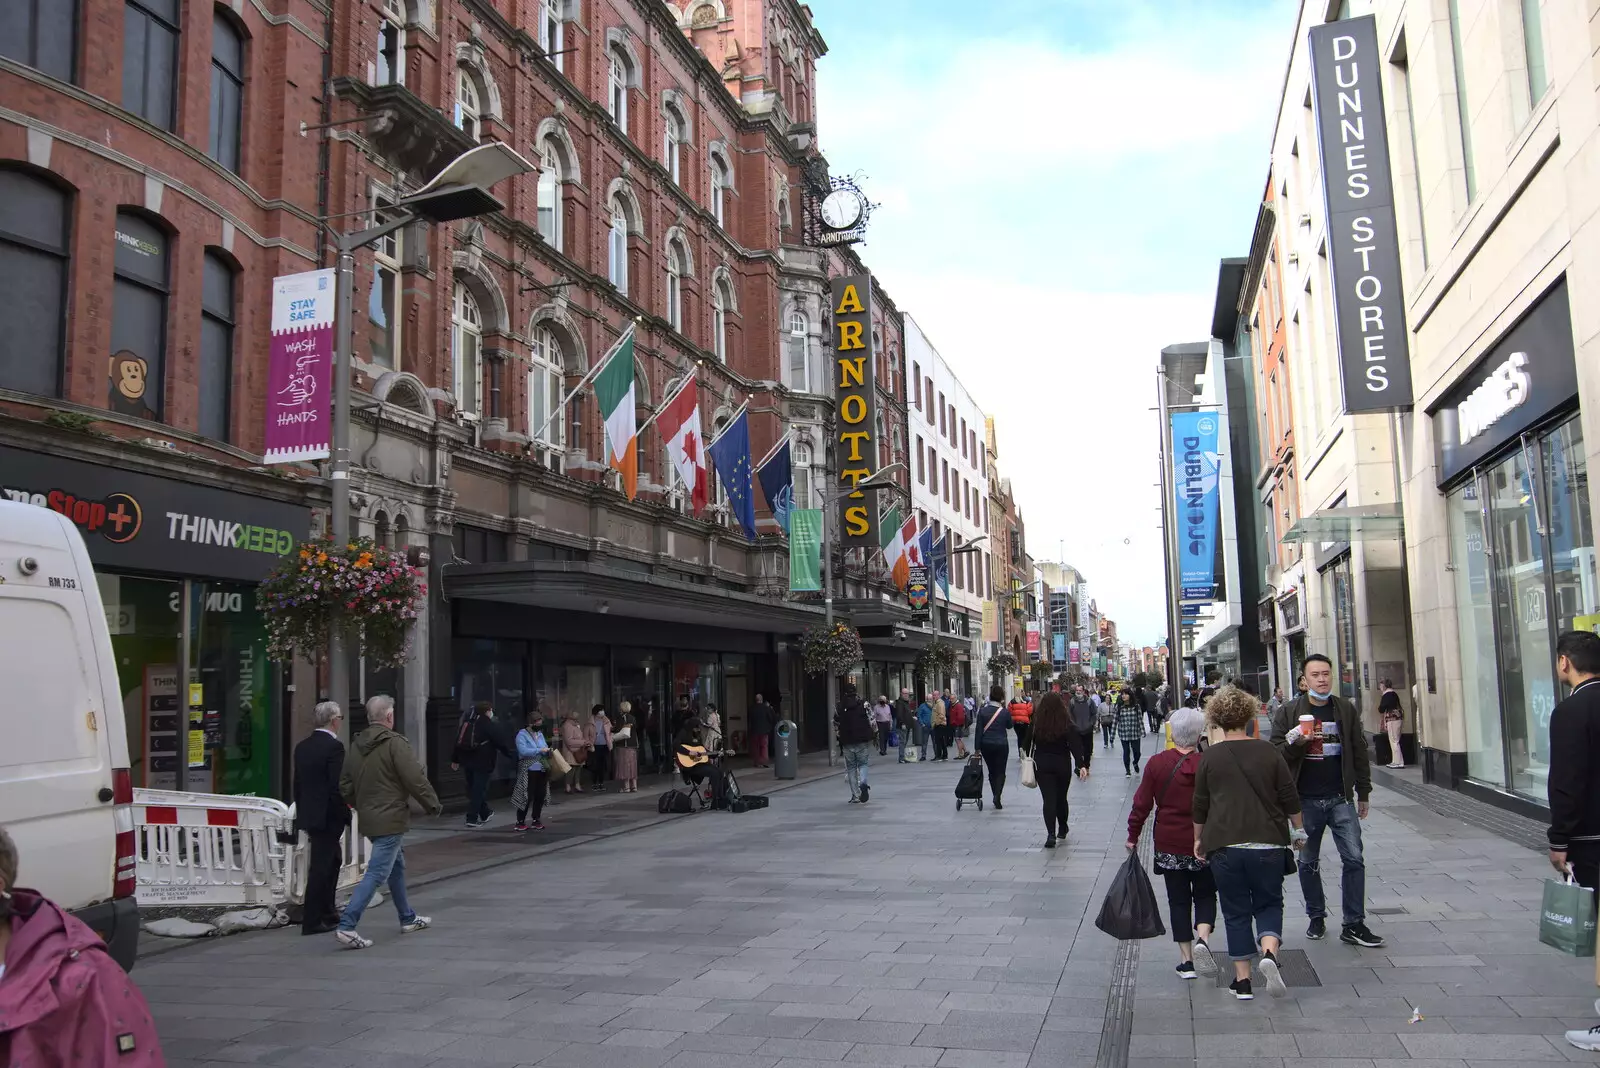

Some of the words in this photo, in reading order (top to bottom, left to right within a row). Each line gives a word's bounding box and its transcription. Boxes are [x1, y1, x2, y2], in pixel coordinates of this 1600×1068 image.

[1332, 35, 1370, 199] DUNNES
[1352, 216, 1389, 393] STORES
[289, 298, 316, 311] STAY
[289, 310, 316, 322] SAFE
[285, 336, 316, 354] WASH
[277, 409, 318, 427] HANDS
[835, 283, 872, 537] ARNOTTS
[1183, 436, 1204, 508] DUBLIN
[166, 511, 240, 548] THINK
[48, 577, 61, 588] RM
[61, 578, 76, 589] 733
[240, 645, 253, 709] THINK
